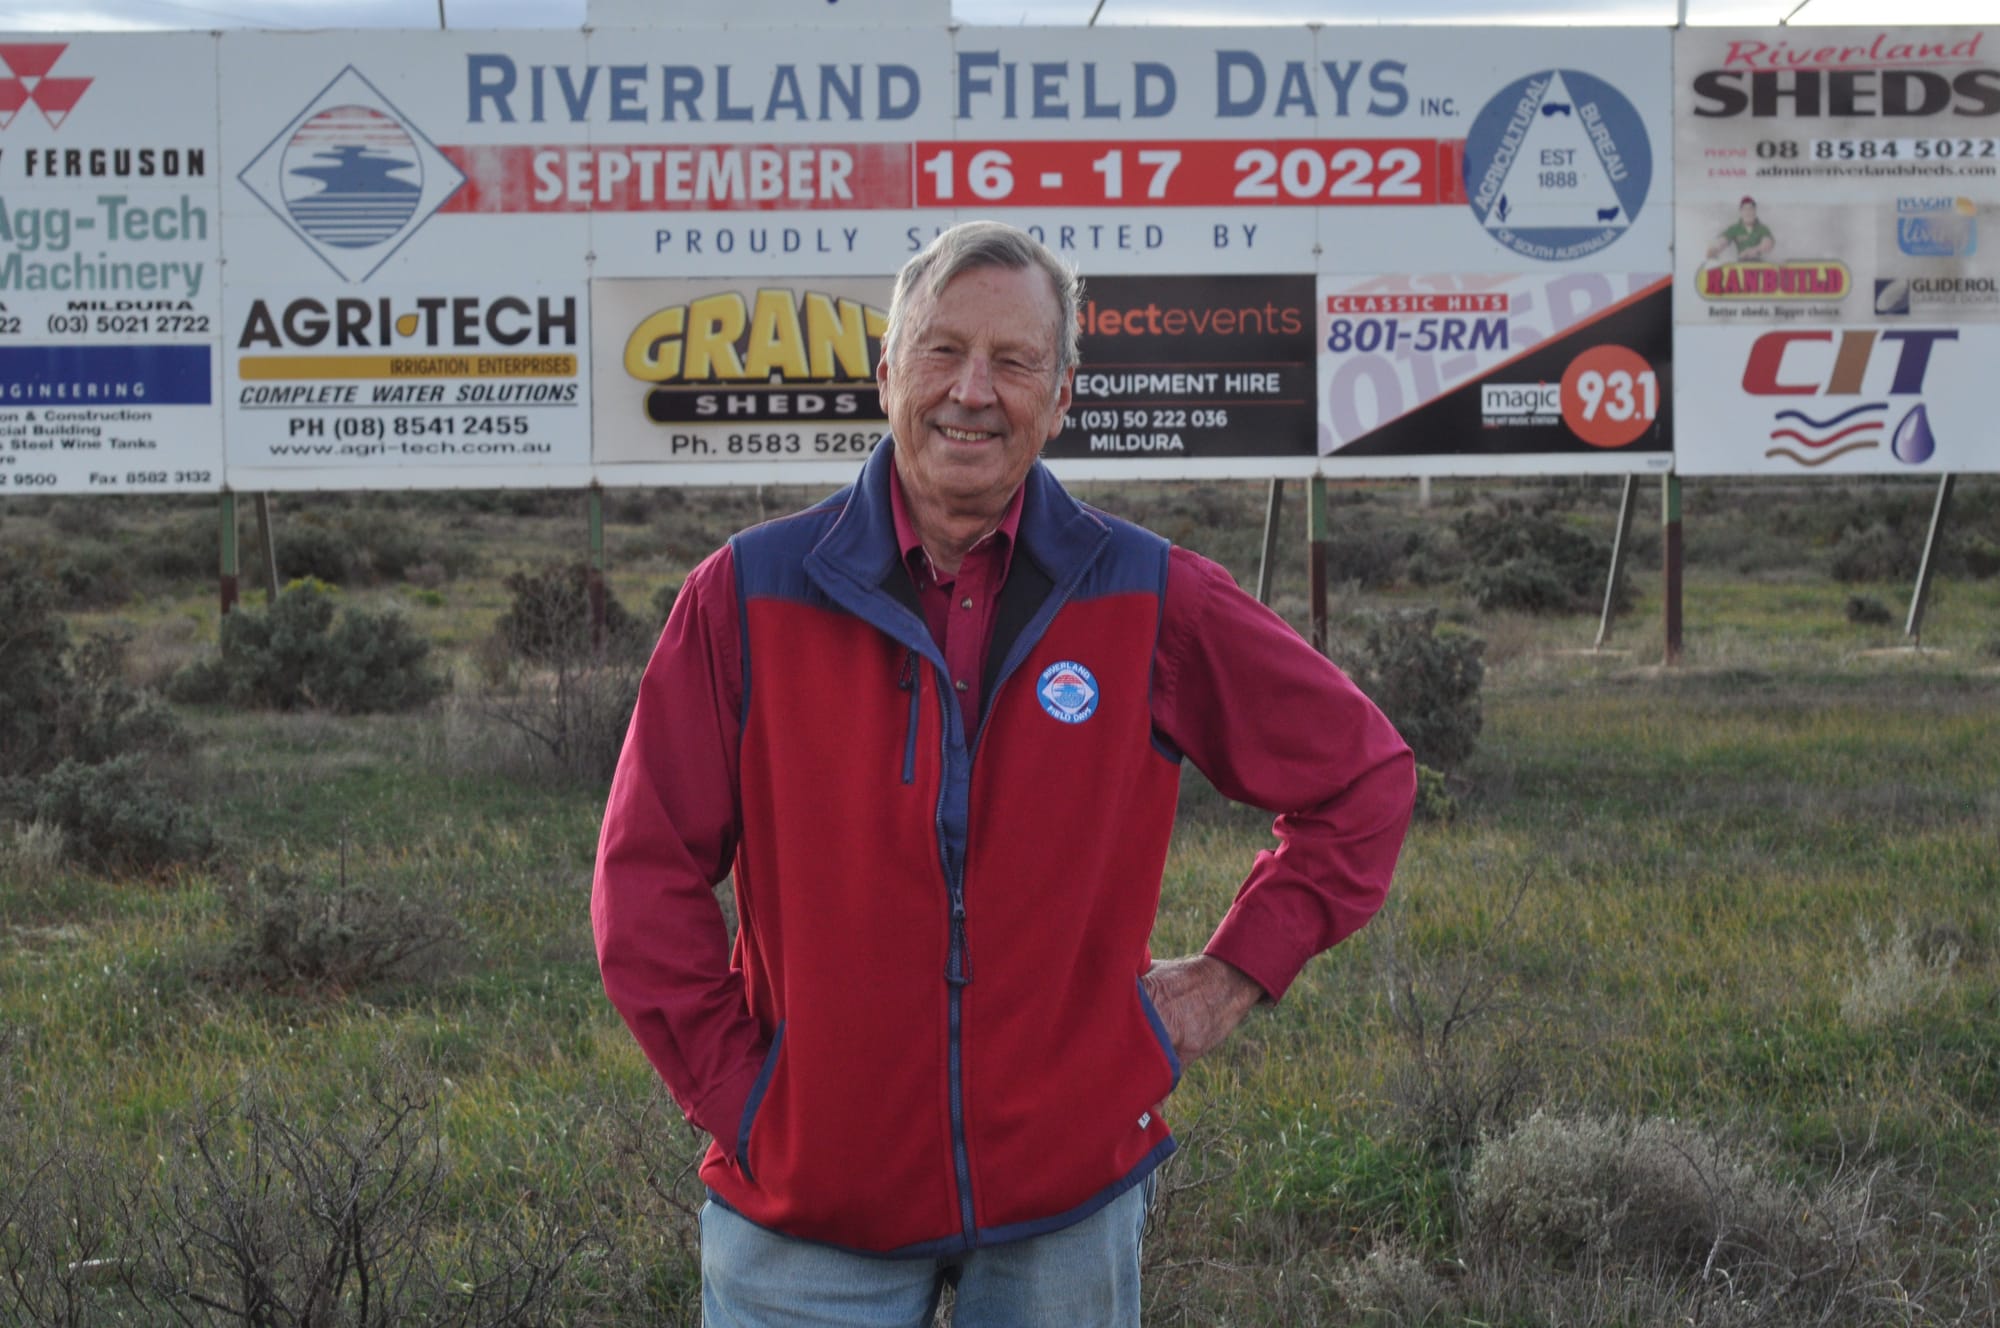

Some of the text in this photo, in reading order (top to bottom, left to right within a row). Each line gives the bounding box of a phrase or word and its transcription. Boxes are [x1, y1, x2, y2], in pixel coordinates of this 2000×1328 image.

[1724, 31, 1983, 68] Riverland
[466, 49, 1460, 124] RIVERLAND FIELD DAYS INC.
[1693, 69, 2000, 118] SHEDS
[1474, 78, 1549, 210] AGRICULTURAL
[1580, 102, 1628, 182] BUREAU
[1755, 139, 1799, 159] 08
[1815, 139, 1899, 159] 8584
[1914, 138, 1996, 158] 5022
[26, 148, 205, 176] FERGUSON
[1540, 150, 1575, 166] EST
[532, 149, 854, 203] SEPTEMBER
[924, 149, 1014, 199] 16
[1093, 149, 1182, 198] 17
[1233, 148, 1422, 197] 2022
[1538, 172, 1577, 187] 1888
[655, 225, 1259, 254] PROUDLY SORTED BY
[0, 251, 204, 298] Machinery
[1705, 266, 1843, 295] RANBUILD
[1912, 278, 1998, 293] GLIDEROL
[67, 301, 193, 311] MILDURA
[1333, 294, 1503, 312] CLASSIC HITS
[47, 314, 88, 334] (03)
[97, 316, 148, 333] 5021
[157, 316, 209, 332] 2722
[1328, 319, 1509, 352] 801-5RM
[390, 357, 571, 375] IRRIGATION ENTERPRISES
[1742, 329, 1958, 395] CIT
[0, 383, 145, 398] GINEERING
[240, 384, 578, 404] COMPLETE WATER SOLUTIONS
[1075, 373, 1280, 397] EQUIPMENT HIRE
[696, 394, 857, 414] SHEDS
[1487, 382, 1557, 415] magic
[26, 412, 35, 421] &
[45, 411, 152, 422] Construction
[1081, 410, 1118, 430] (03)
[1123, 411, 1147, 428] 50
[1152, 410, 1186, 427] 222
[1191, 409, 1227, 427] 036
[33, 425, 101, 437] Building
[289, 416, 529, 440] PH (08) 8541 2455
[11, 440, 53, 450] Steel
[61, 439, 101, 450] Wine
[109, 438, 157, 449] Tanks
[269, 441, 551, 456] www.agri-tech.com.au
[672, 434, 717, 454] Ph.
[728, 434, 800, 453] 8583
[1090, 434, 1184, 450] MILDURA
[14, 474, 57, 485] 9500
[90, 472, 117, 485] Fax
[174, 471, 211, 483] 3132
[1043, 662, 1090, 679] RIVERLAND
[1047, 705, 1070, 721] FIELD
